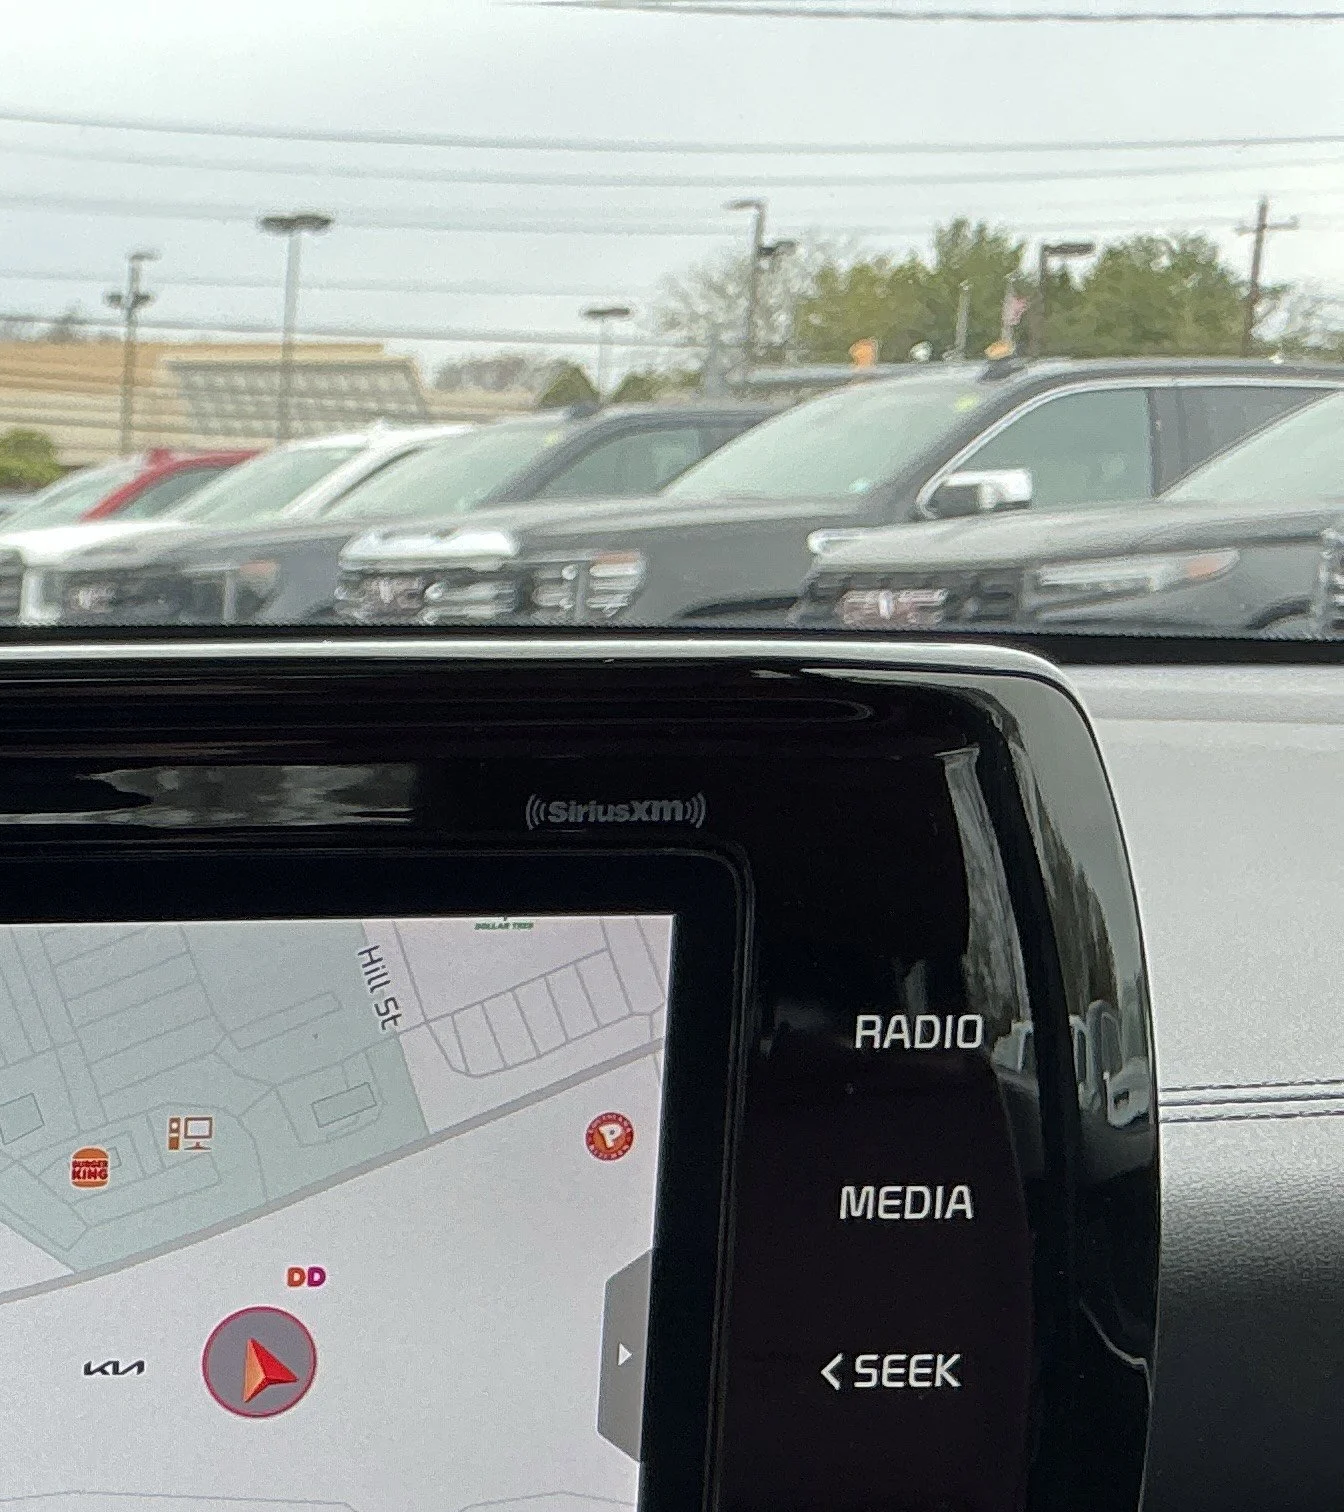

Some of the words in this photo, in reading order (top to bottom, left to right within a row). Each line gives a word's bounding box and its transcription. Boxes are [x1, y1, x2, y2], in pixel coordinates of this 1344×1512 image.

[357, 945, 391, 993] Hill
[374, 997, 402, 1030] St
[856, 1015, 983, 1048] RADIO
[72, 1168, 108, 1180] KING
[840, 1185, 973, 1219] MEDIA
[287, 1267, 327, 1288] DD
[854, 1354, 960, 1387] SEEK
